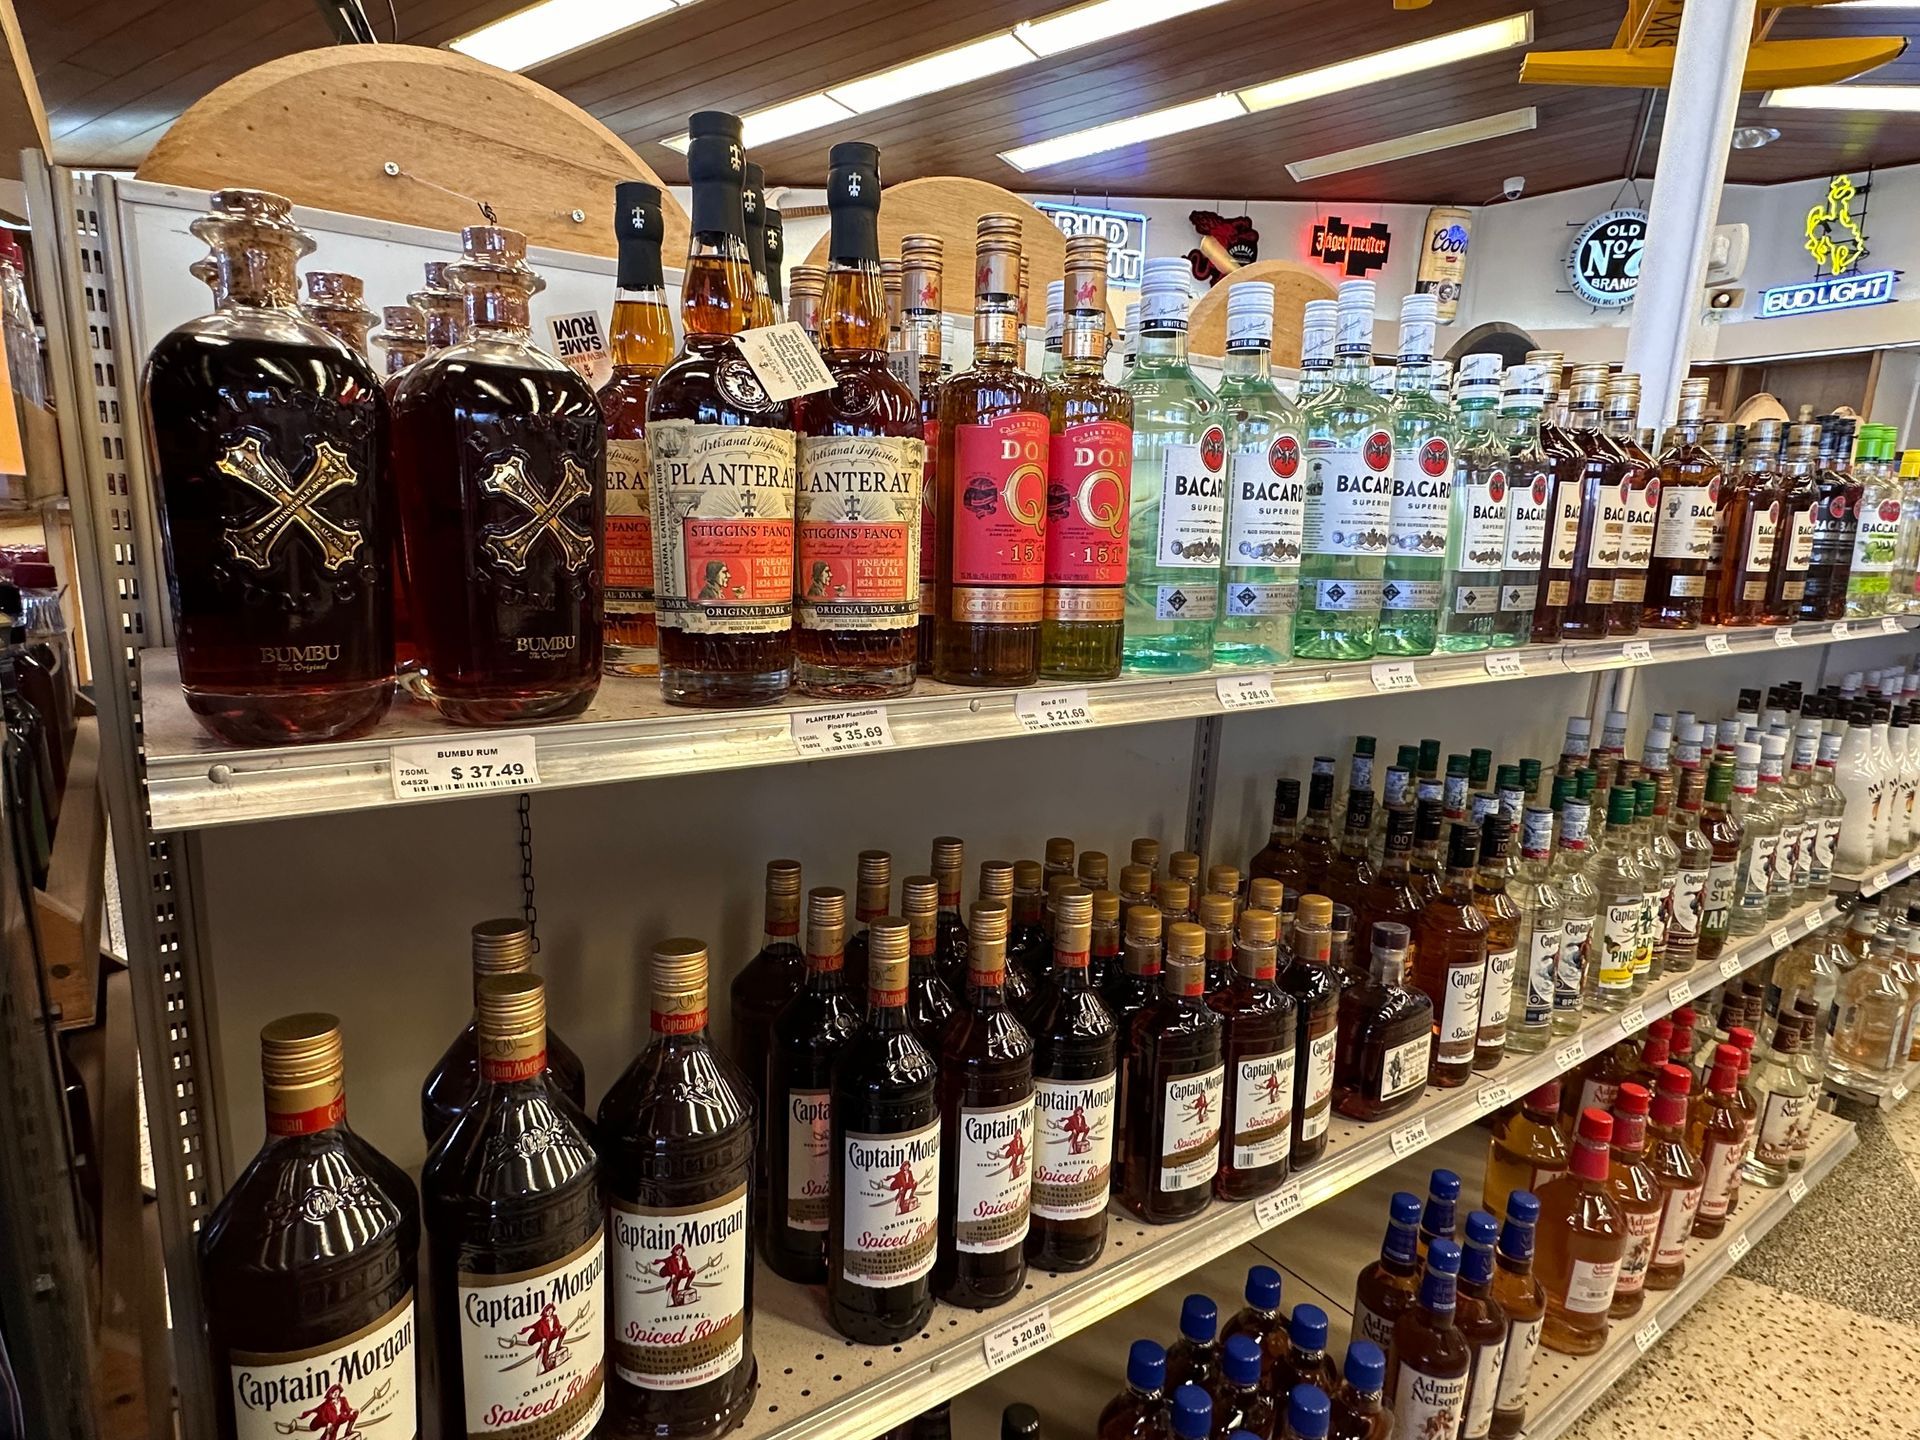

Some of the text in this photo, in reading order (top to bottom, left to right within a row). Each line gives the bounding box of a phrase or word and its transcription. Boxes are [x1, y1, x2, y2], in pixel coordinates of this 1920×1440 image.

[1606, 224, 1640, 236] OLD
[1591, 278, 1639, 291] BRAND
[1768, 278, 1887, 312] BUD LIGHT
[553, 316, 595, 335] RUM
[560, 335, 602, 356] SAME
[693, 434, 789, 457] Artisanal Infusion
[805, 444, 900, 464] Artisanal Infusion
[606, 450, 640, 465] nfusion
[1074, 447, 1127, 467] DON
[671, 462, 795, 488] PLANTERAY
[799, 471, 912, 493] LANTERAY
[1175, 475, 1225, 499] BACAR
[1242, 482, 1304, 503] BACARD
[1337, 475, 1392, 495] BACAR
[1393, 480, 1451, 499] BACARD
[1000, 462, 1045, 537] Q
[1073, 468, 1125, 539] Q
[1191, 503, 1223, 513] SUPERIO
[658, 487, 667, 539] CARIBBEAN
[1259, 507, 1300, 516] SUPERIOR
[1473, 505, 1506, 519] BACARD
[1516, 507, 1546, 521] BACAR
[691, 525, 791, 537] STIGGINS' FANCY
[802, 528, 904, 539] STIGGINS' FANCY
[663, 542, 671, 594] ARTISANAL
[856, 558, 904, 567] PINEAPPLE
[763, 567, 789, 577] RUM
[864, 567, 899, 577] RUM
[856, 578, 873, 587] 1824
[620, 591, 644, 599] DARK
[706, 606, 785, 616] ORIGINAL DARK
[816, 604, 896, 614] ORIGINAL DARK
[981, 600, 1019, 610] PUERTO
[516, 635, 576, 652] BUMBU
[259, 644, 341, 664] BUMBU
[528, 651, 567, 661] The Original
[278, 662, 328, 673] The Original
[1240, 689, 1270, 701] $ 28.19
[805, 709, 878, 724] PLANTERAY Plantation
[1047, 708, 1085, 721] $ 21.69
[827, 721, 859, 730] Pineapple
[833, 726, 883, 743] $ 35.69
[437, 748, 499, 759] BUMBU RUM
[400, 768, 430, 777] 750ML
[451, 763, 525, 781] $ 37.49
[660, 1014, 693, 1033] Captain
[1242, 1060, 1276, 1081] Captain
[1170, 1079, 1204, 1101] Captain
[1034, 1089, 1079, 1112] aptain
[792, 1098, 830, 1125] Capta
[965, 1114, 1018, 1144] Captain
[1246, 1114, 1276, 1129] Spiced
[1173, 1135, 1202, 1150] Spiced
[848, 1141, 904, 1172] Captain
[1057, 1160, 1094, 1168] ORIGINAL
[1034, 1165, 1082, 1183] Spiced
[973, 1198, 1020, 1218] Spiced
[1274, 1193, 1298, 1211] $ 17.79
[614, 1208, 744, 1252] Captain Morgan
[884, 1217, 923, 1231] ORIGINAL
[857, 1230, 910, 1249] Spiced
[465, 1250, 604, 1328] Captain Morgan
[654, 1312, 706, 1324] ORIGINAL
[625, 1312, 735, 1345] Spiced Rum
[1012, 1322, 1047, 1347] $ 20.89
[1362, 1324, 1390, 1347] Nels
[237, 1320, 412, 1412] Captain Morgan
[522, 1368, 577, 1398] ORIGINAL
[1412, 1376, 1465, 1394] Admiral
[483, 1388, 560, 1428] Spiced
